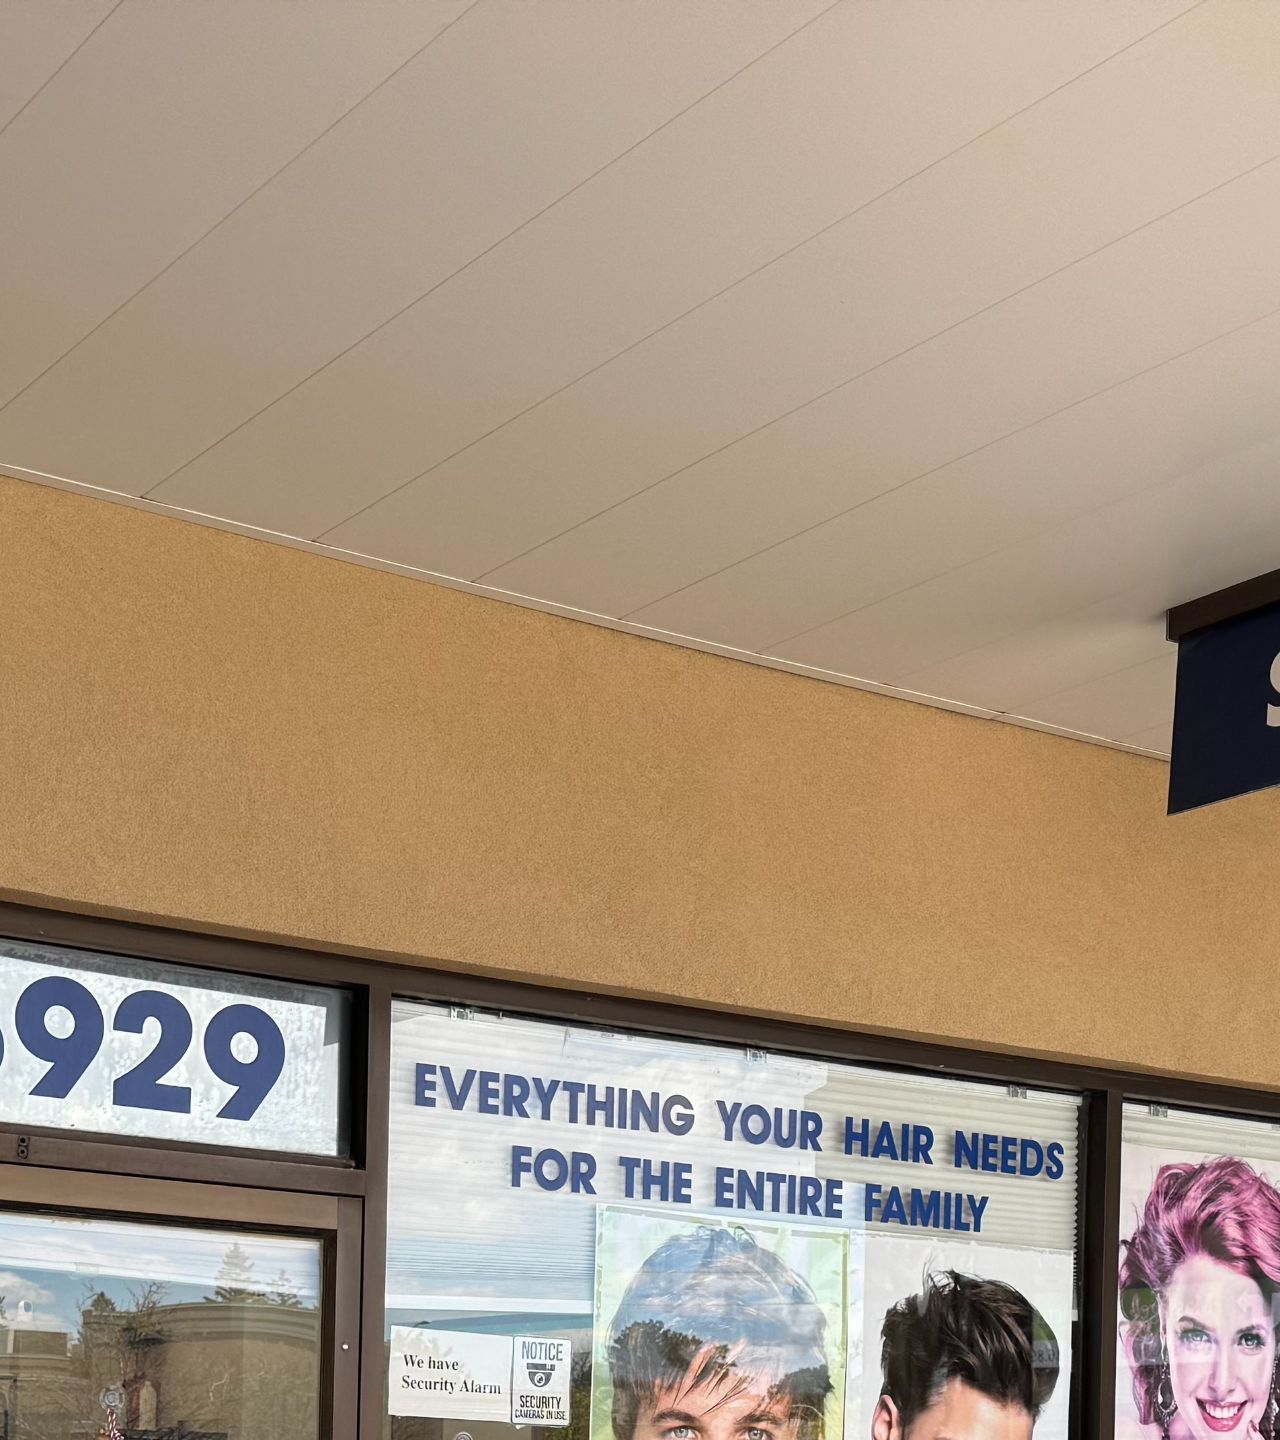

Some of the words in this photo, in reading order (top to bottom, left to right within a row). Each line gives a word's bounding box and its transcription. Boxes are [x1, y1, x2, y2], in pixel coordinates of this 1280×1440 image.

[414, 1062, 695, 1137] EVERYTHING
[717, 1098, 824, 1153] YOUR
[843, 1115, 934, 1165] HAIR
[953, 1130, 1065, 1181] NEEDS
[511, 1144, 597, 1196] FOR
[619, 1156, 694, 1205] THE
[715, 1166, 844, 1219] ENTIRE
[865, 1183, 989, 1234] FAMILY
[522, 1341, 563, 1362] NOTICE
[403, 1354, 424, 1369] We
[428, 1356, 459, 1371] have
[402, 1375, 457, 1394] Security
[460, 1379, 501, 1395] Alarm
[519, 1395, 562, 1410] SECURITY
[515, 1409, 545, 1420] CAMERAS
[546, 1410, 553, 1420] IN
